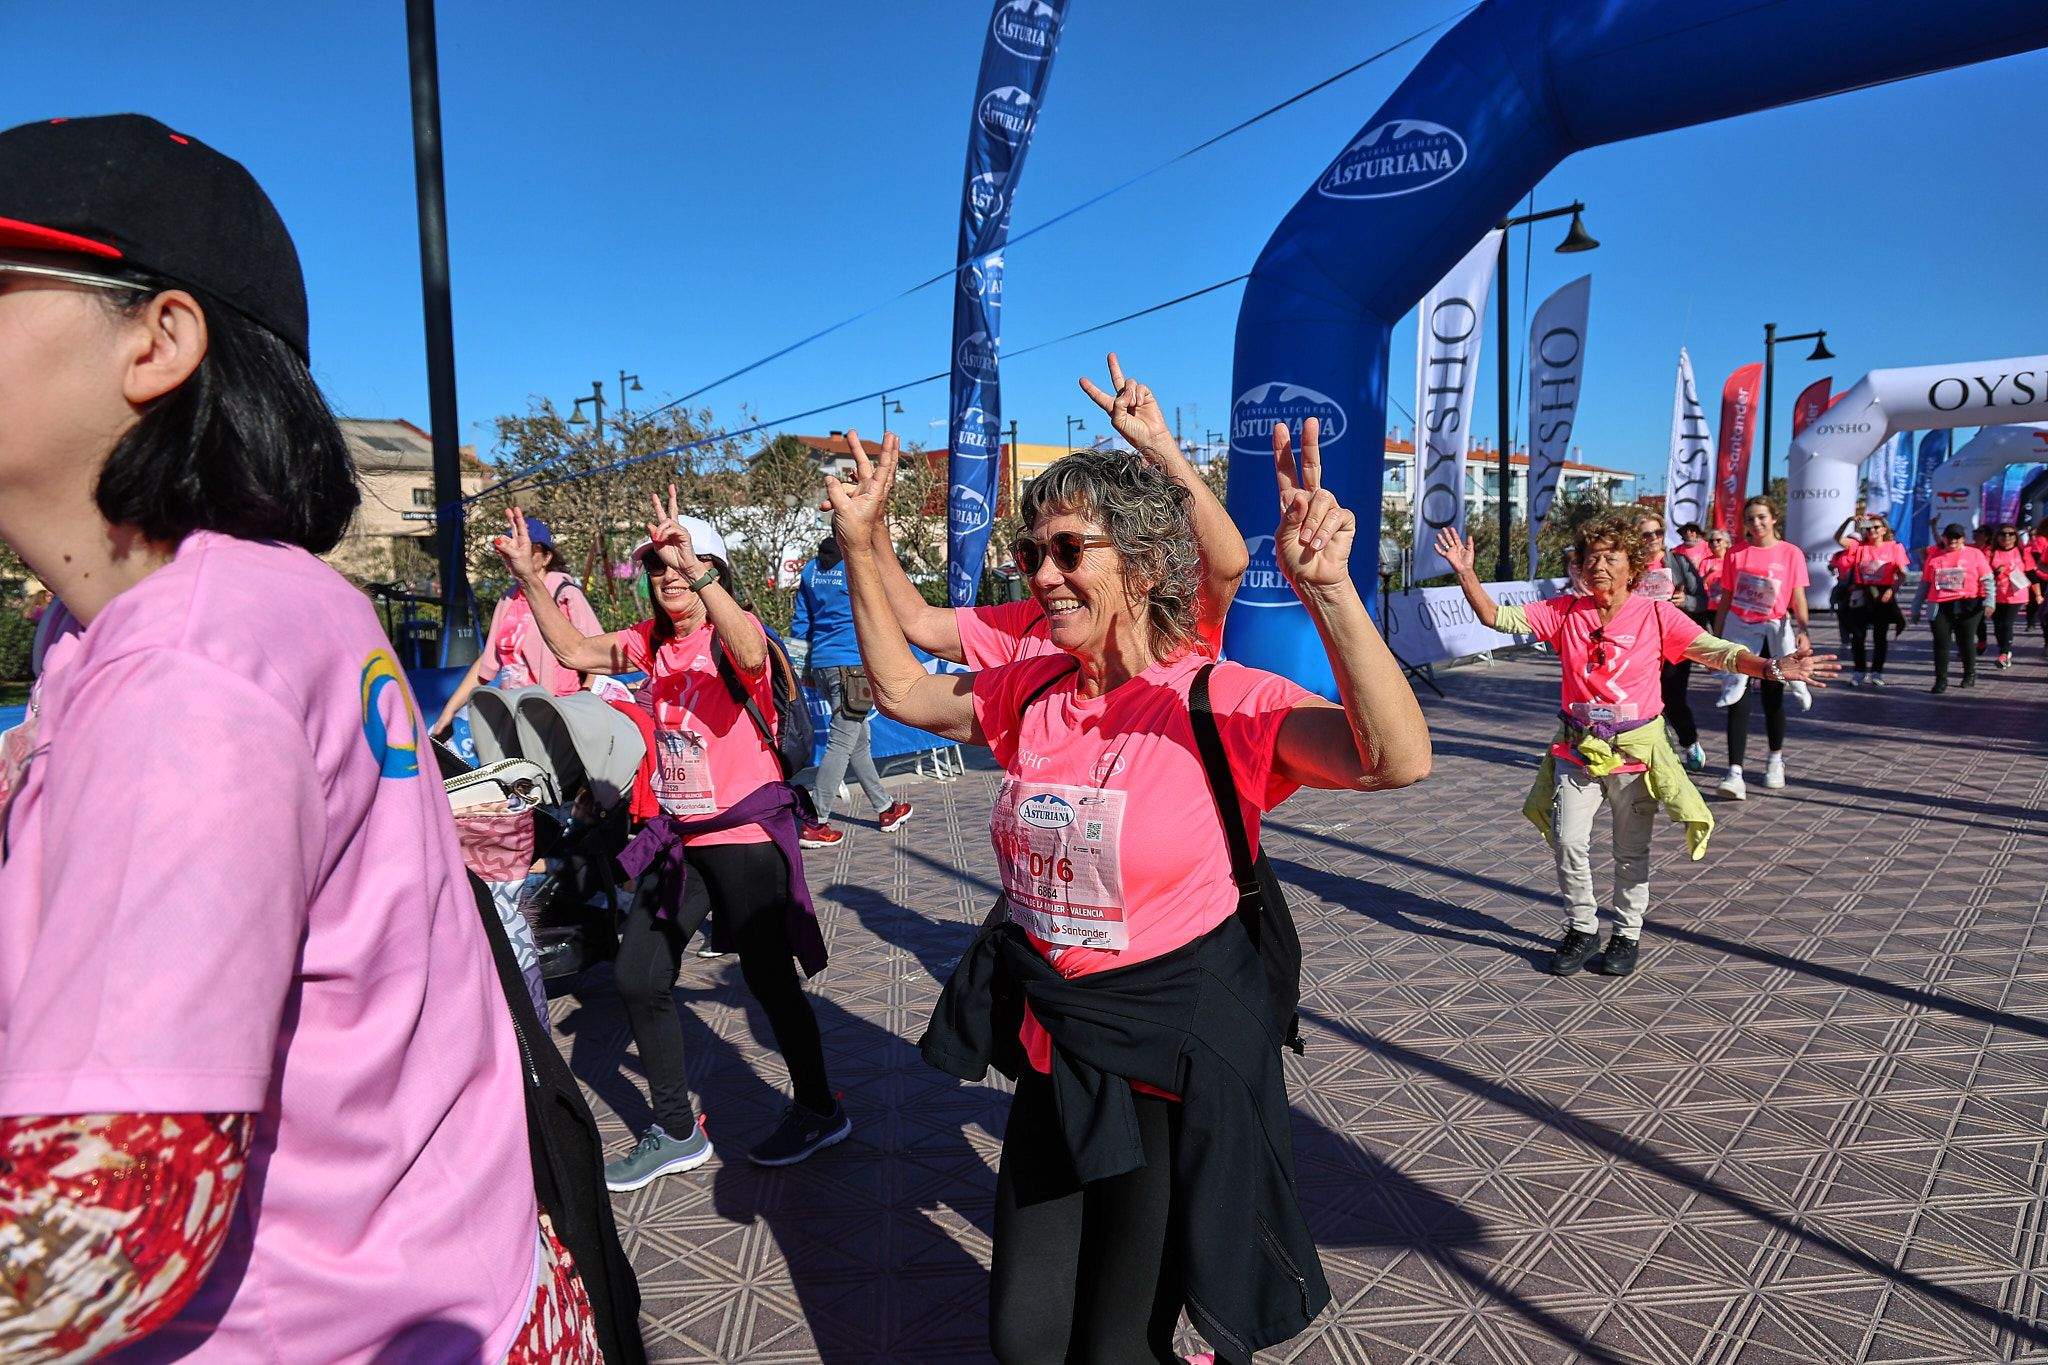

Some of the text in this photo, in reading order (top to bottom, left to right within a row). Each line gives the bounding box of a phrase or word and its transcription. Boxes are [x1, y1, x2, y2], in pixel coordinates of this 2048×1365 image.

[998, 13, 1046, 47] ASTURIA
[1324, 149, 1454, 190] ASTURIANA
[1928, 371, 2048, 411] OYS
[1242, 406, 1332, 416] CENTRAL LECHERA
[1421, 297, 1476, 529] OYSHO
[1233, 412, 1335, 438] ASTUAA
[1728, 387, 1750, 471] Santander
[1817, 423, 1871, 435] OYSHO
[1792, 488, 1840, 500] OYSHO
[1418, 597, 1474, 631] OYSHO
[664, 767, 685, 781] 016
[1023, 804, 1070, 822] ASTURIANA
[1029, 852, 1074, 883] 016
[1037, 885, 1058, 900] 6864
[1070, 907, 1104, 918] VALENCIA
[1061, 925, 1108, 939] Santander
